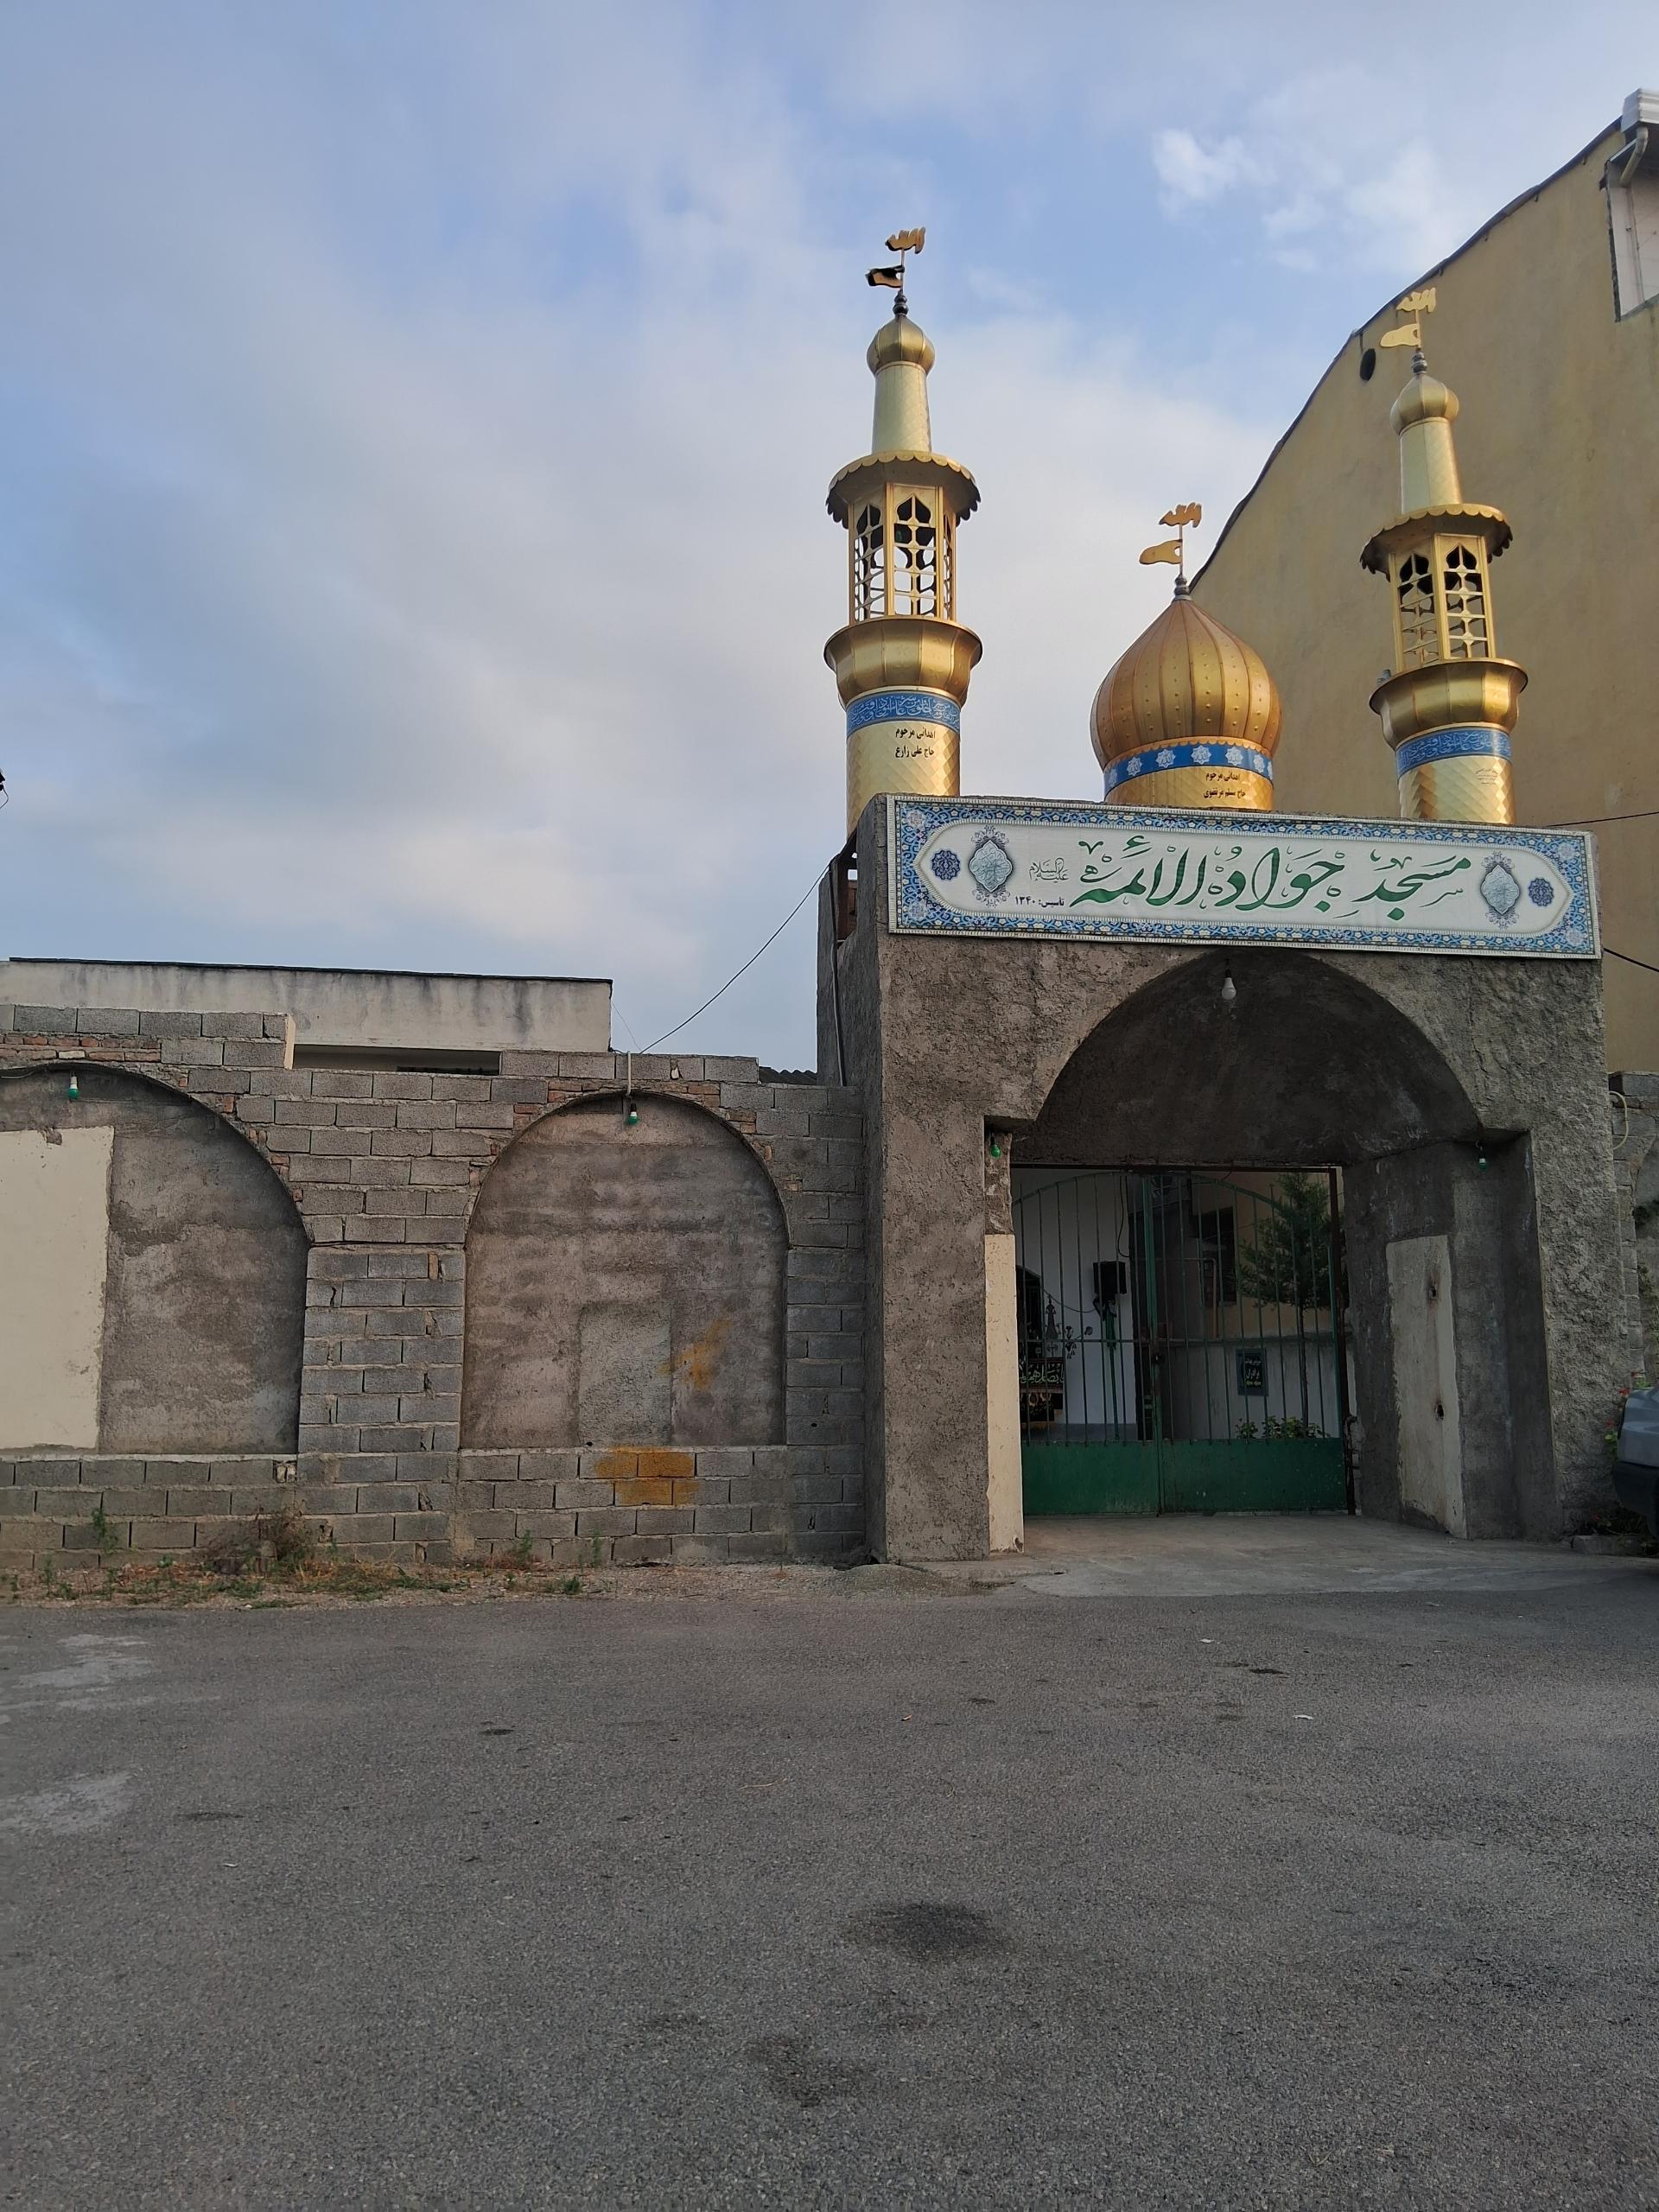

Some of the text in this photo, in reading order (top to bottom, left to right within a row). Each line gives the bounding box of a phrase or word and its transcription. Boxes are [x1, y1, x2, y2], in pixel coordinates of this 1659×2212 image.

[896, 728, 915, 739] مرحوم
[911, 745, 923, 758] علی
[924, 747, 935, 758] حاج
[1205, 772, 1223, 782] مرحوم
[1236, 789, 1246, 799] حاج
[1351, 849, 1471, 921] مسجد
